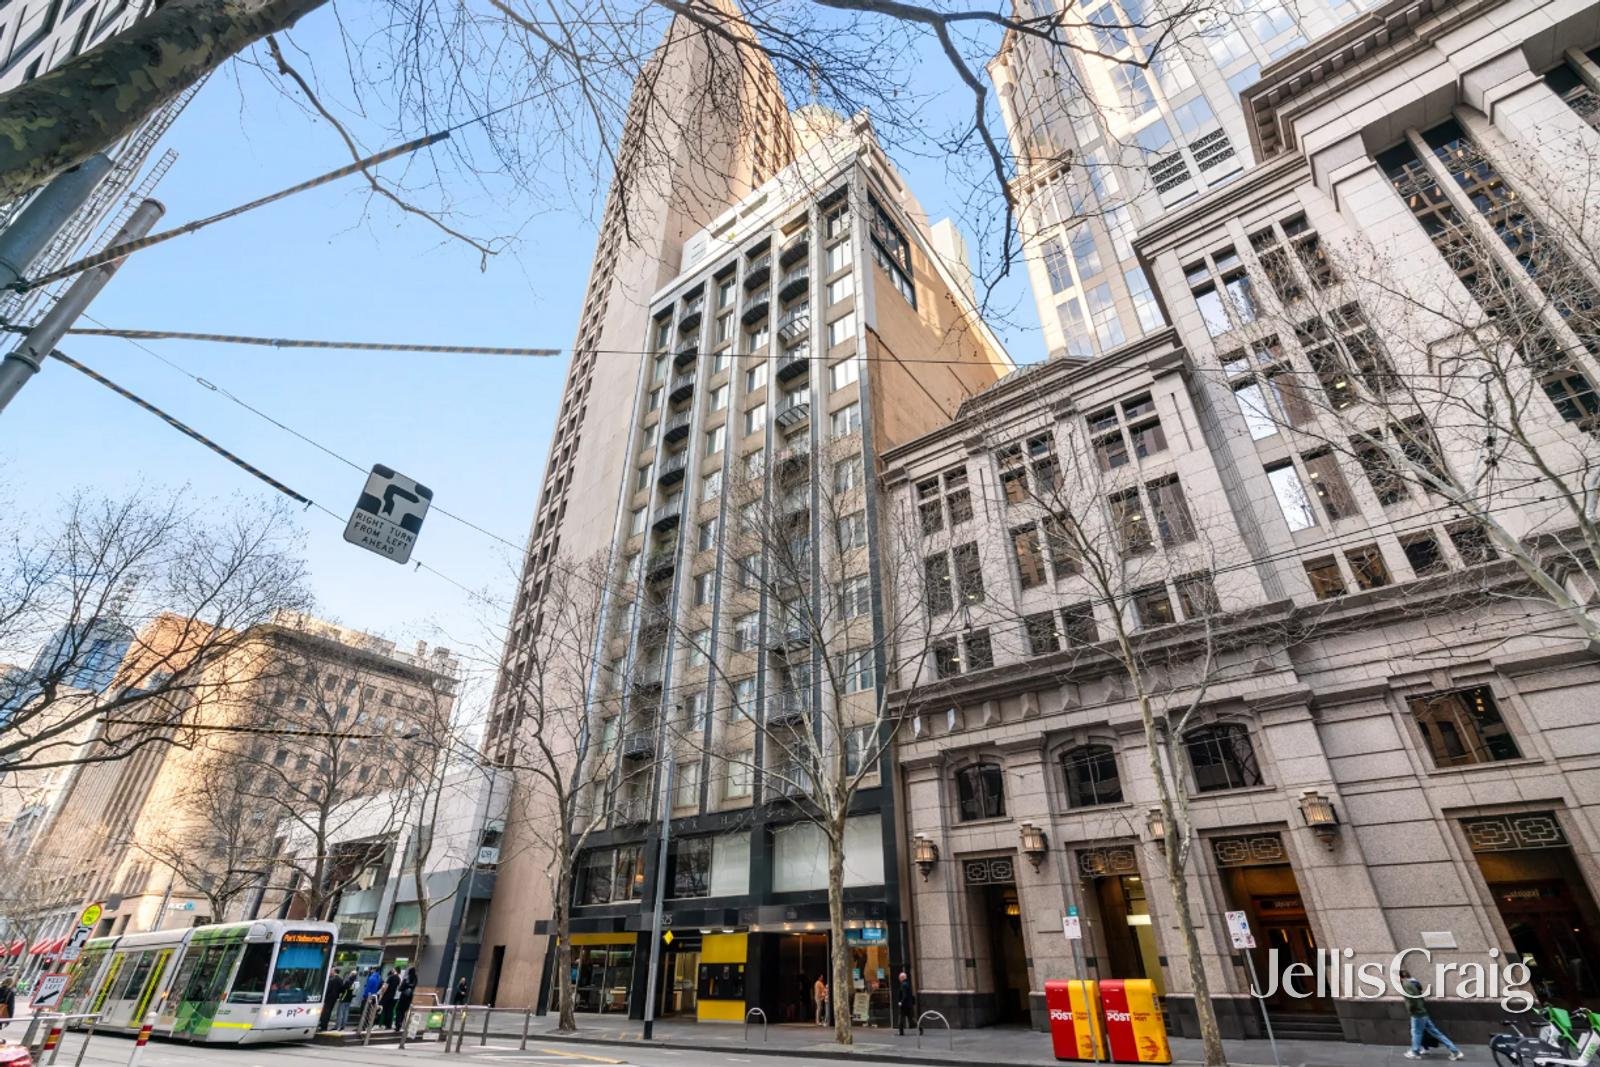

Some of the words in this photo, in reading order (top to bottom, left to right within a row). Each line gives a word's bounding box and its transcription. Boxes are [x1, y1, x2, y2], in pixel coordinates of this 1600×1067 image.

[354, 521, 380, 537] FROM
[386, 536, 408, 550] LEFT
[356, 512, 384, 529] RIGHT
[390, 527, 414, 543] TURN
[362, 536, 394, 555] AHEAD
[1050, 1012, 1073, 1020] POST
[1106, 1013, 1131, 1021] POST
